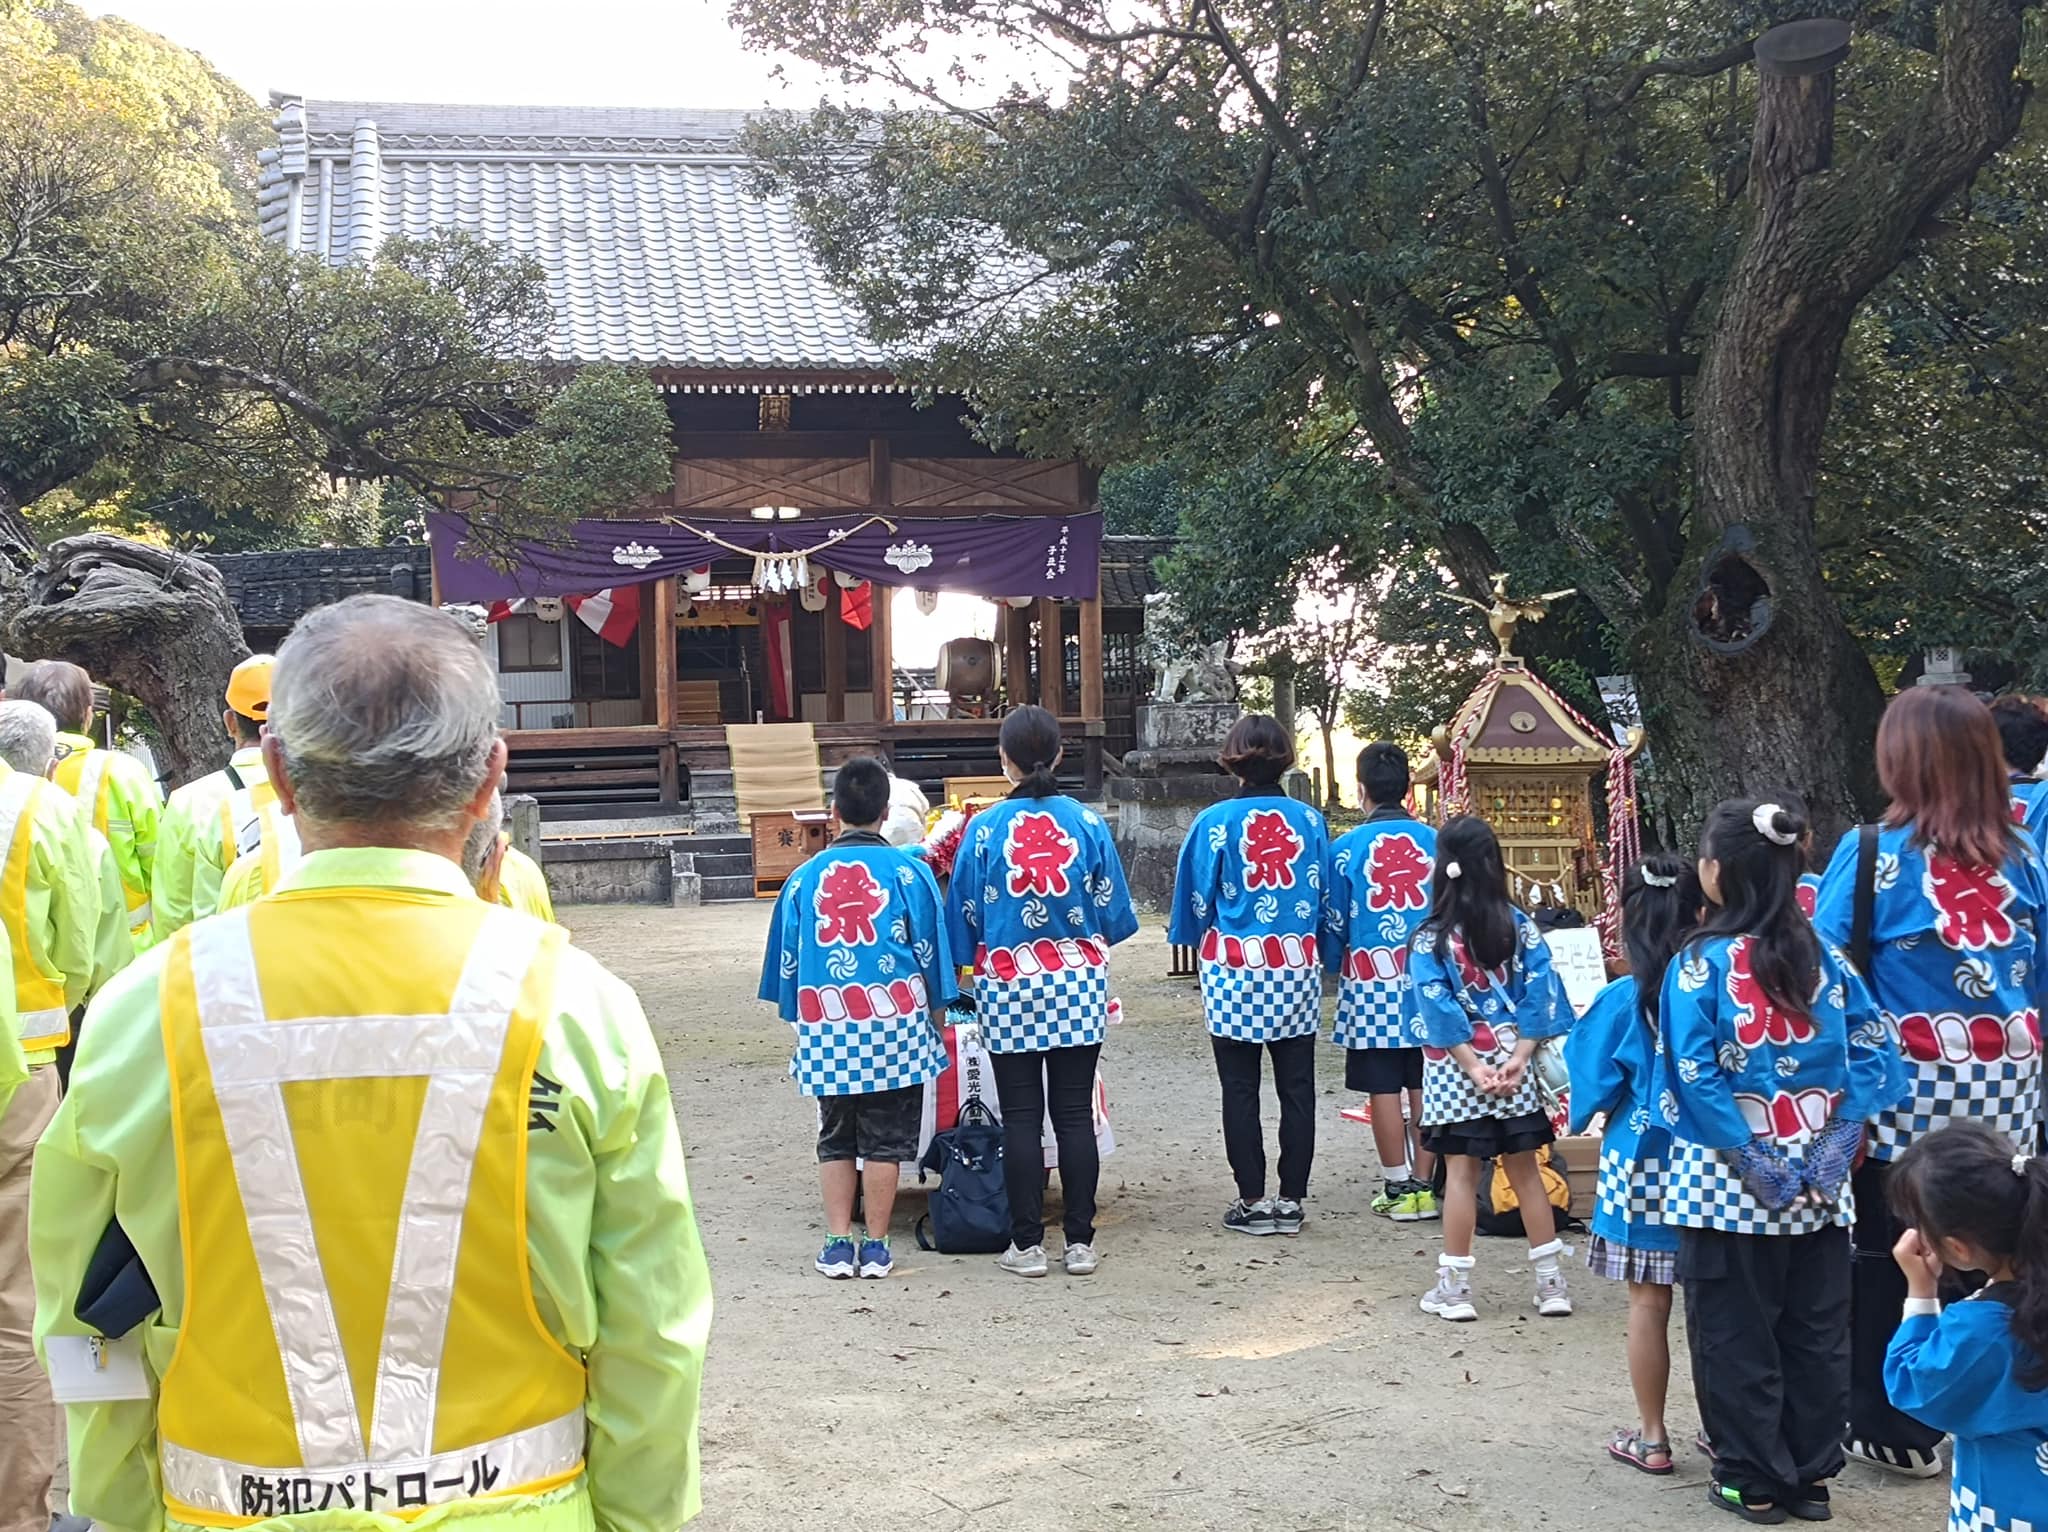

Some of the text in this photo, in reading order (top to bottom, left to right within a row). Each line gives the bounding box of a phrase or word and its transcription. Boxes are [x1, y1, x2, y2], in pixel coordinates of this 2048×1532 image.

[1057, 525, 1069, 575] 平成十三年
[1003, 810, 1079, 897] 祭
[1239, 809, 1304, 892] 祭
[1364, 833, 1434, 912] 祭
[813, 860, 889, 947] 祭
[240, 1454, 500, 1517] 防犯パトロール
